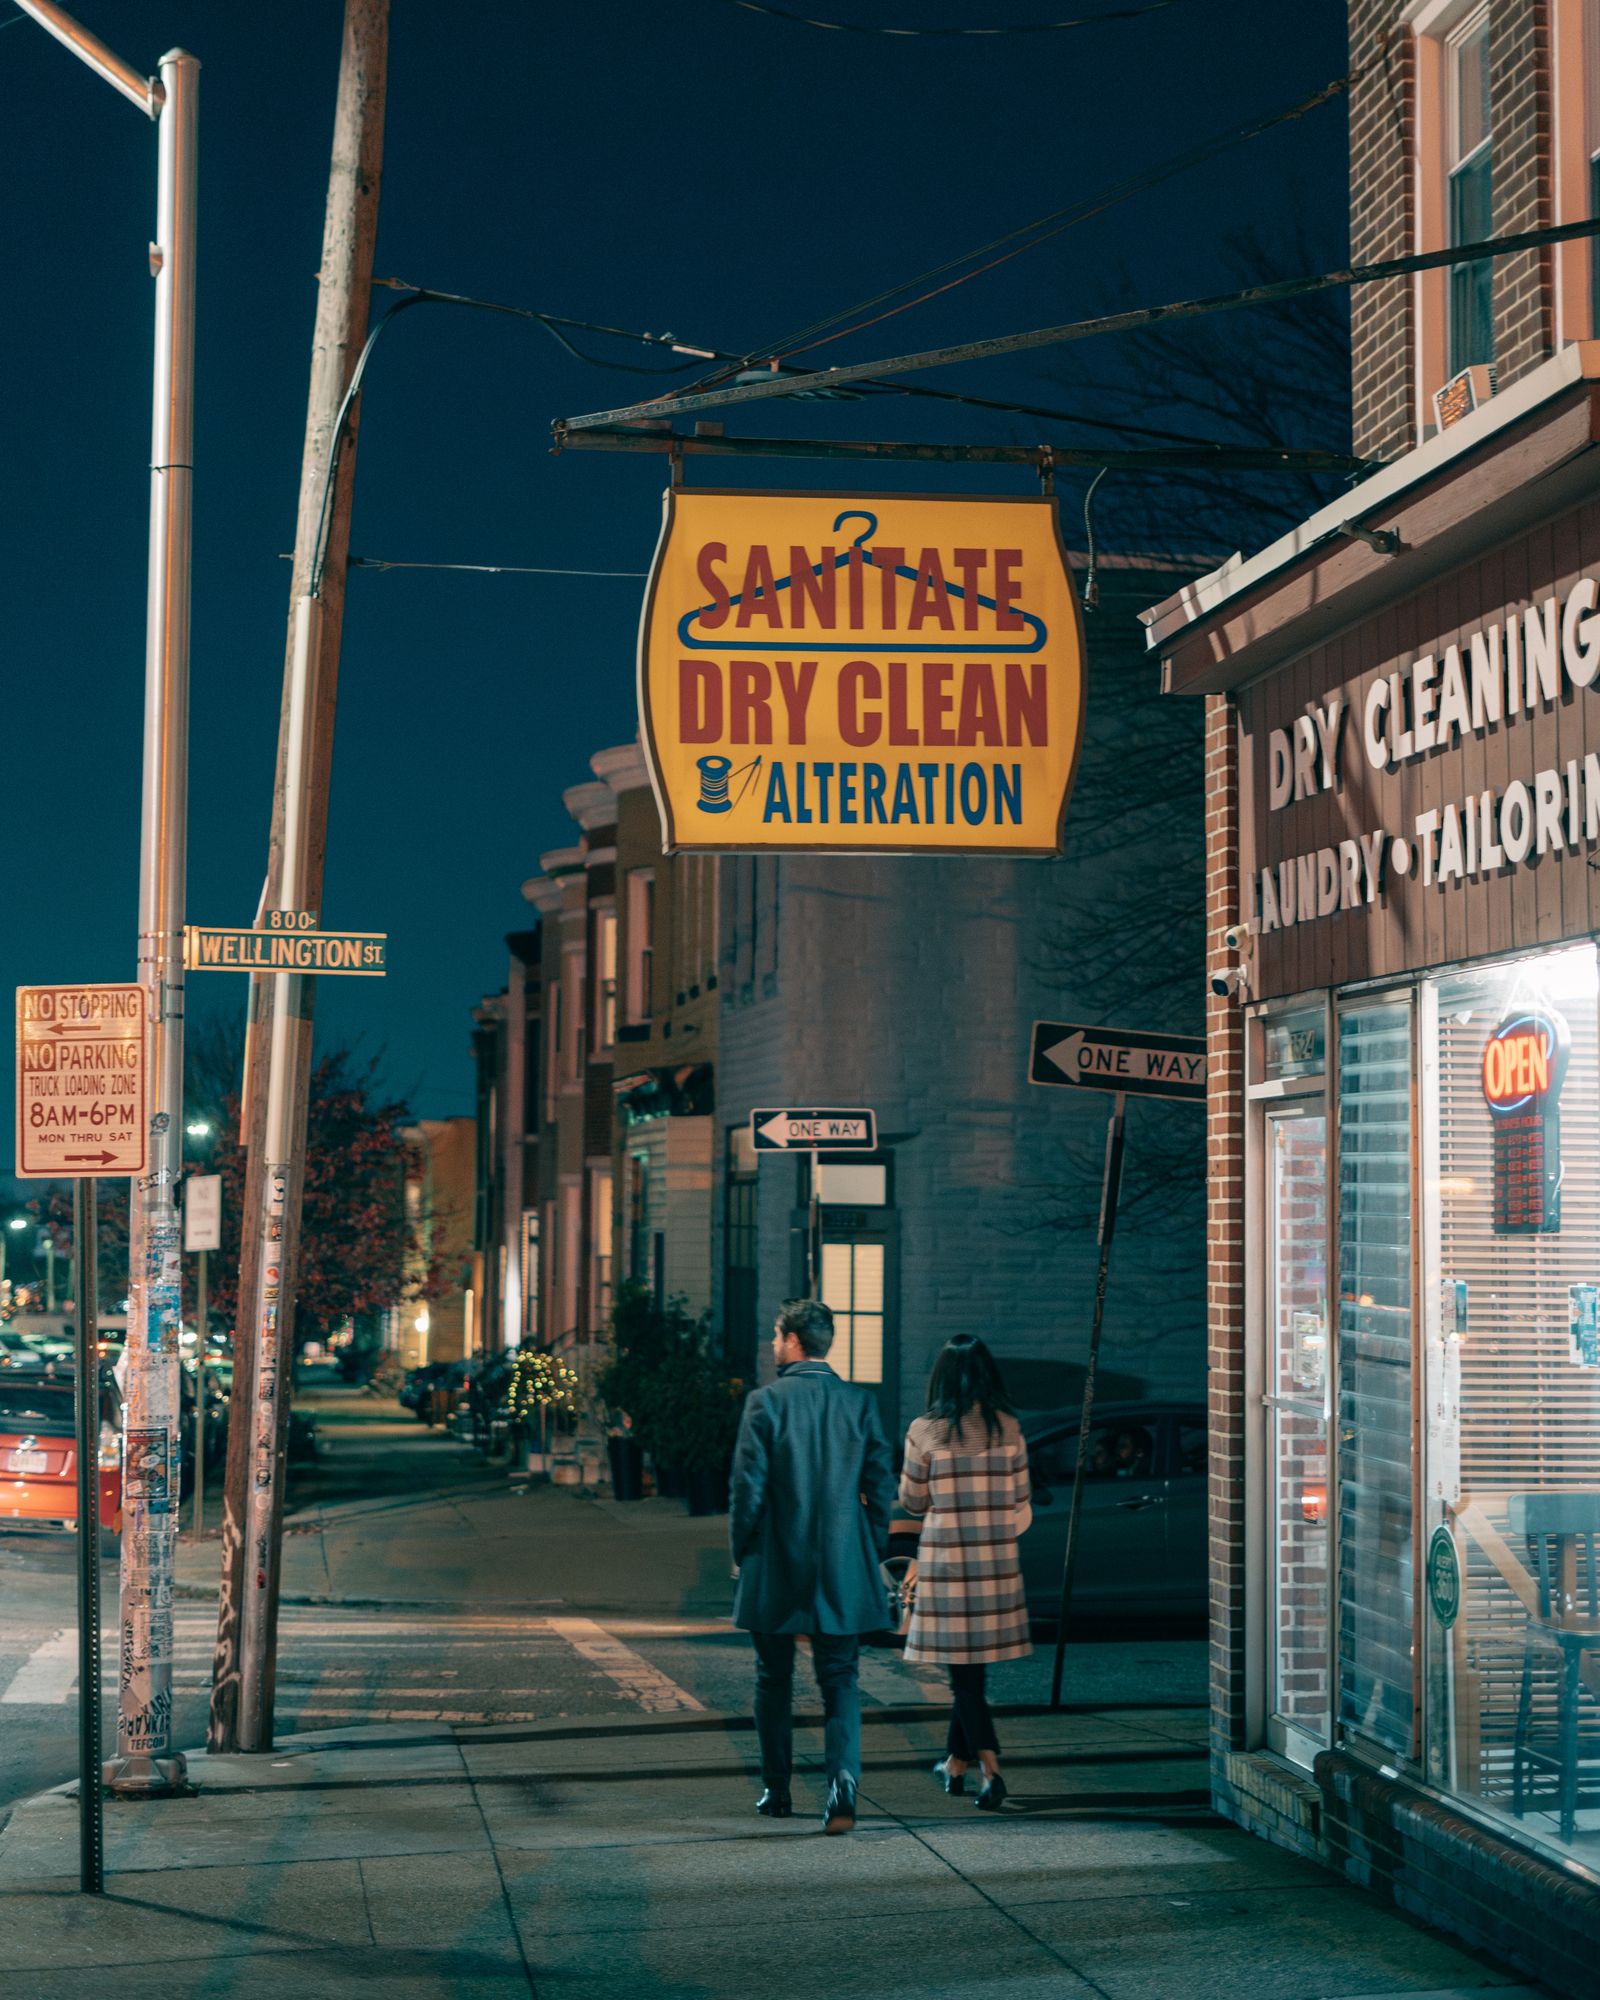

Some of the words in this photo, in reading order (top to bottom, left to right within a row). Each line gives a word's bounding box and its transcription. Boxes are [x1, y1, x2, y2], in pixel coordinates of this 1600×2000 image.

[697, 541, 1025, 632] SANITATE
[679, 660, 818, 745] DRY
[837, 661, 1048, 747] CLEAN
[1269, 699, 1343, 812] DRY
[1364, 578, 1600, 769] CLEANING
[762, 761, 1023, 826] ALTERATION
[1248, 829, 1384, 936] LAUNDRY
[270, 911, 309, 930] 800
[201, 934, 363, 968] WELLINGTON
[24, 993, 54, 1020] NO
[60, 993, 138, 1020] STOPPING
[24, 1043, 54, 1070] NO
[60, 1044, 138, 1070] PARKING
[1077, 1046, 1131, 1073] ONE
[1147, 1053, 1202, 1080] WAY
[1485, 1033, 1548, 1099] OPEN
[29, 1075, 60, 1097] TRUCK
[64, 1074, 106, 1096] LOADING
[111, 1073, 136, 1095] ZONE
[38, 1133, 66, 1143] MON
[70, 1133, 103, 1143] THRU
[109, 1131, 133, 1142] SAT
[789, 1121, 822, 1137] ONE
[828, 1121, 861, 1136] WAY
